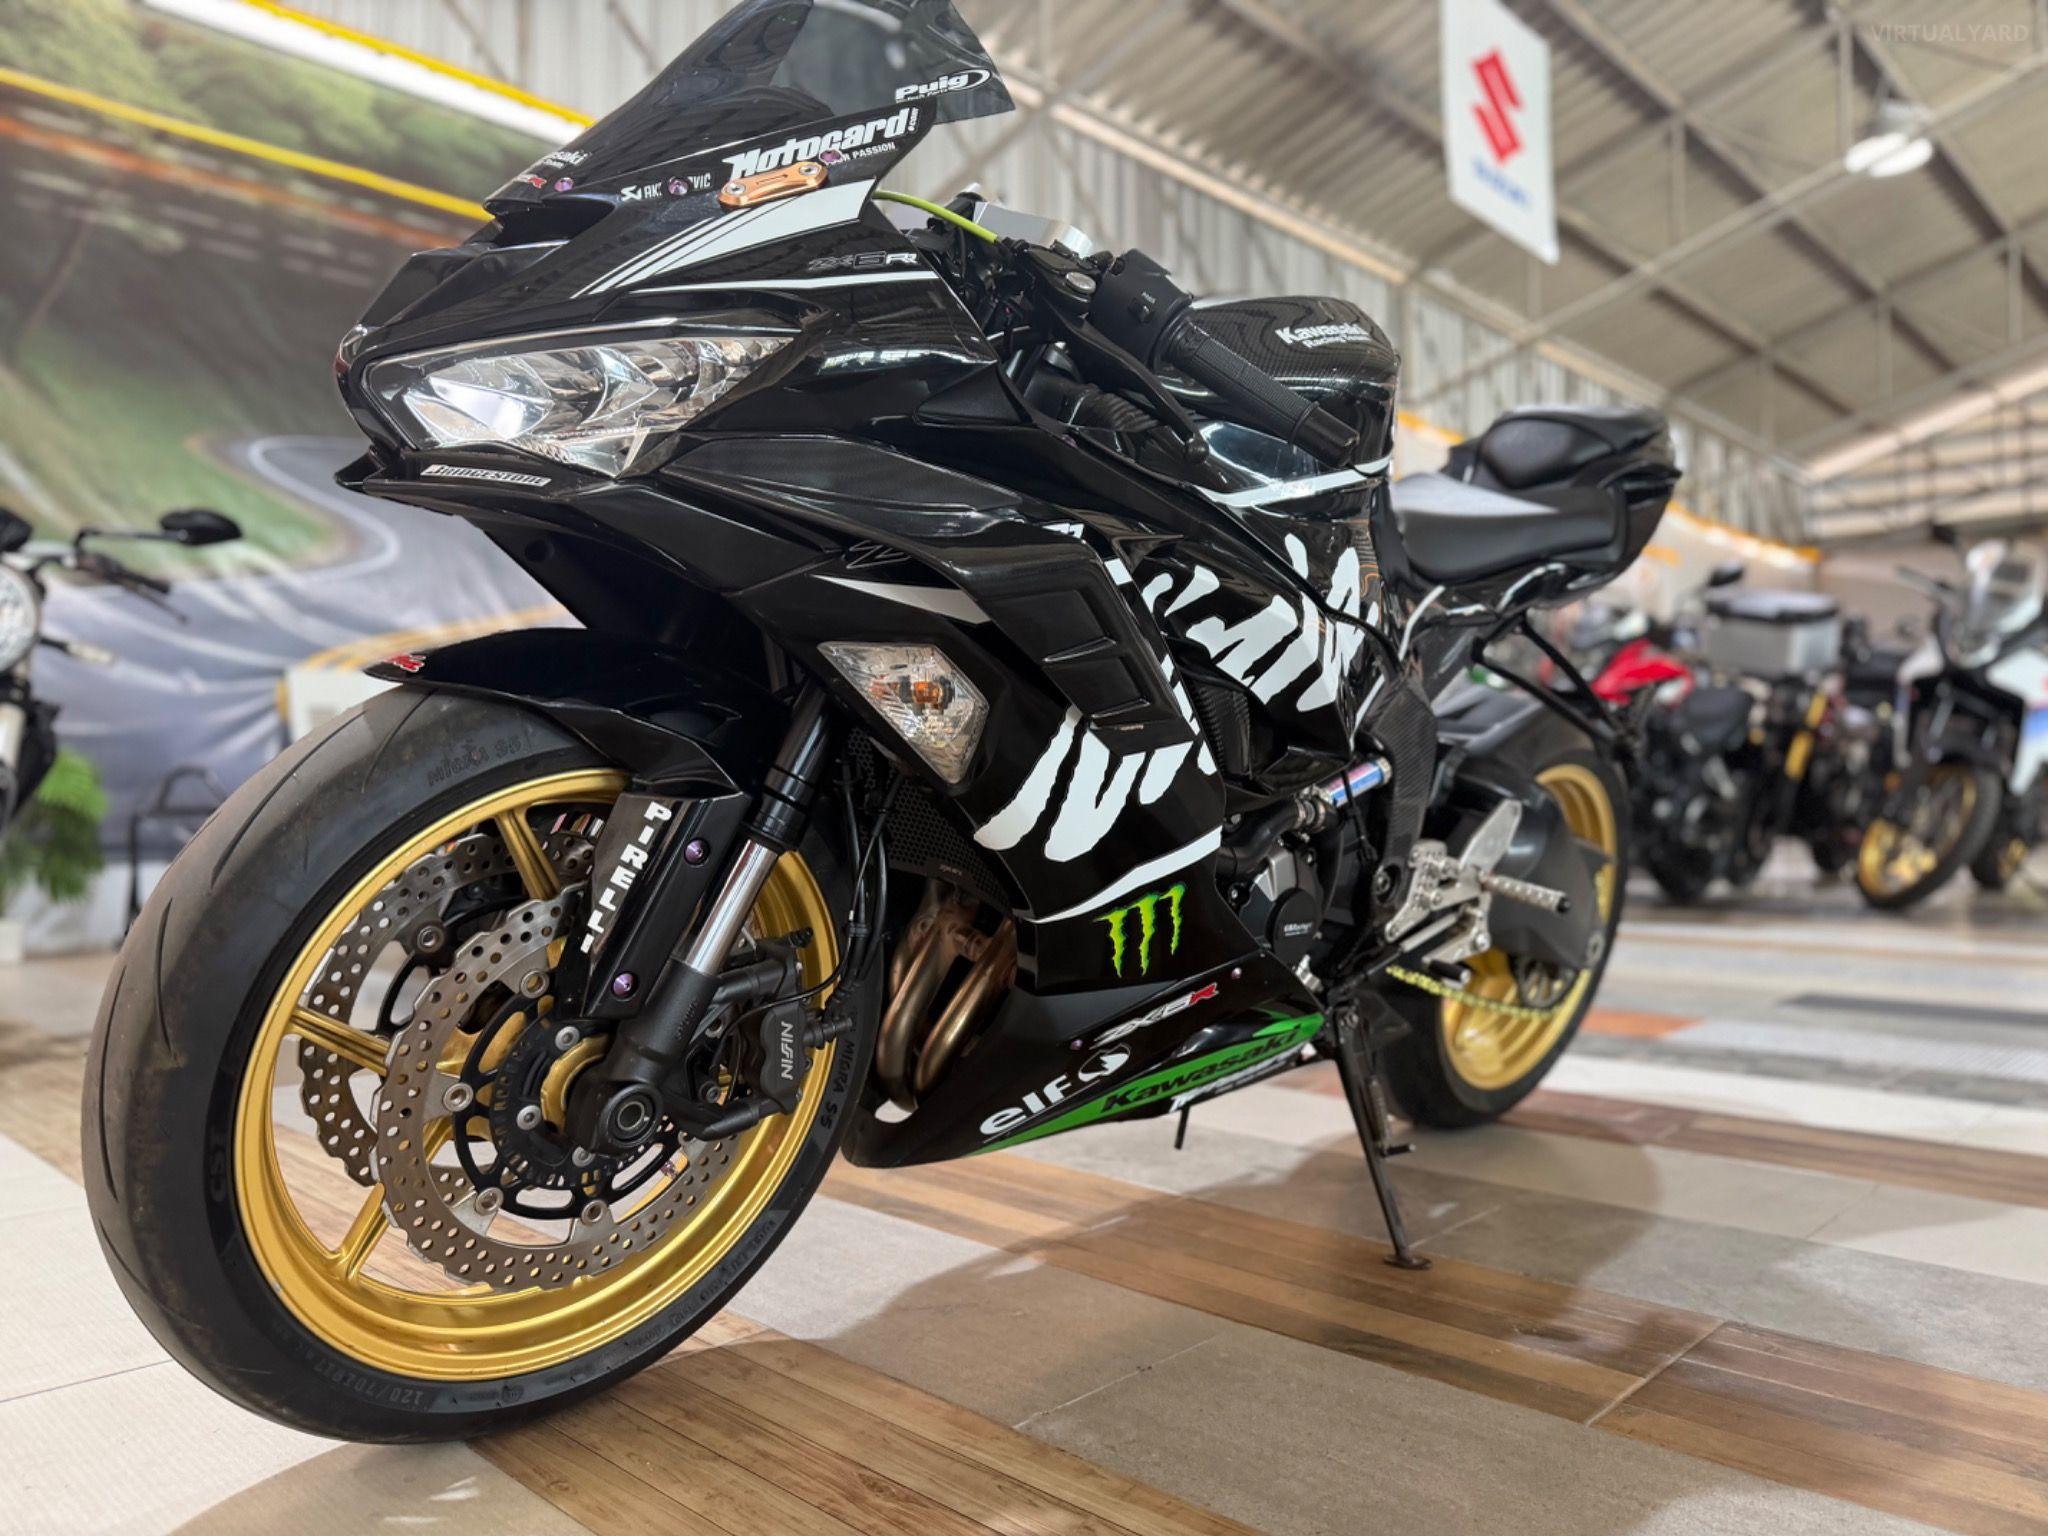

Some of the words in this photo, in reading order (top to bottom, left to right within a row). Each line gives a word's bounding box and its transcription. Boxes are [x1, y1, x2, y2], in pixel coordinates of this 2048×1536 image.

[895, 69, 990, 100] Puig
[722, 107, 910, 179] Motocard
[852, 141, 896, 159] PASSION
[580, 801, 672, 953] PIRELLI
[780, 1020, 794, 1081] NISSIN
[1101, 1025, 1300, 1113] Kawasaki
[979, 1074, 1073, 1136] elf
